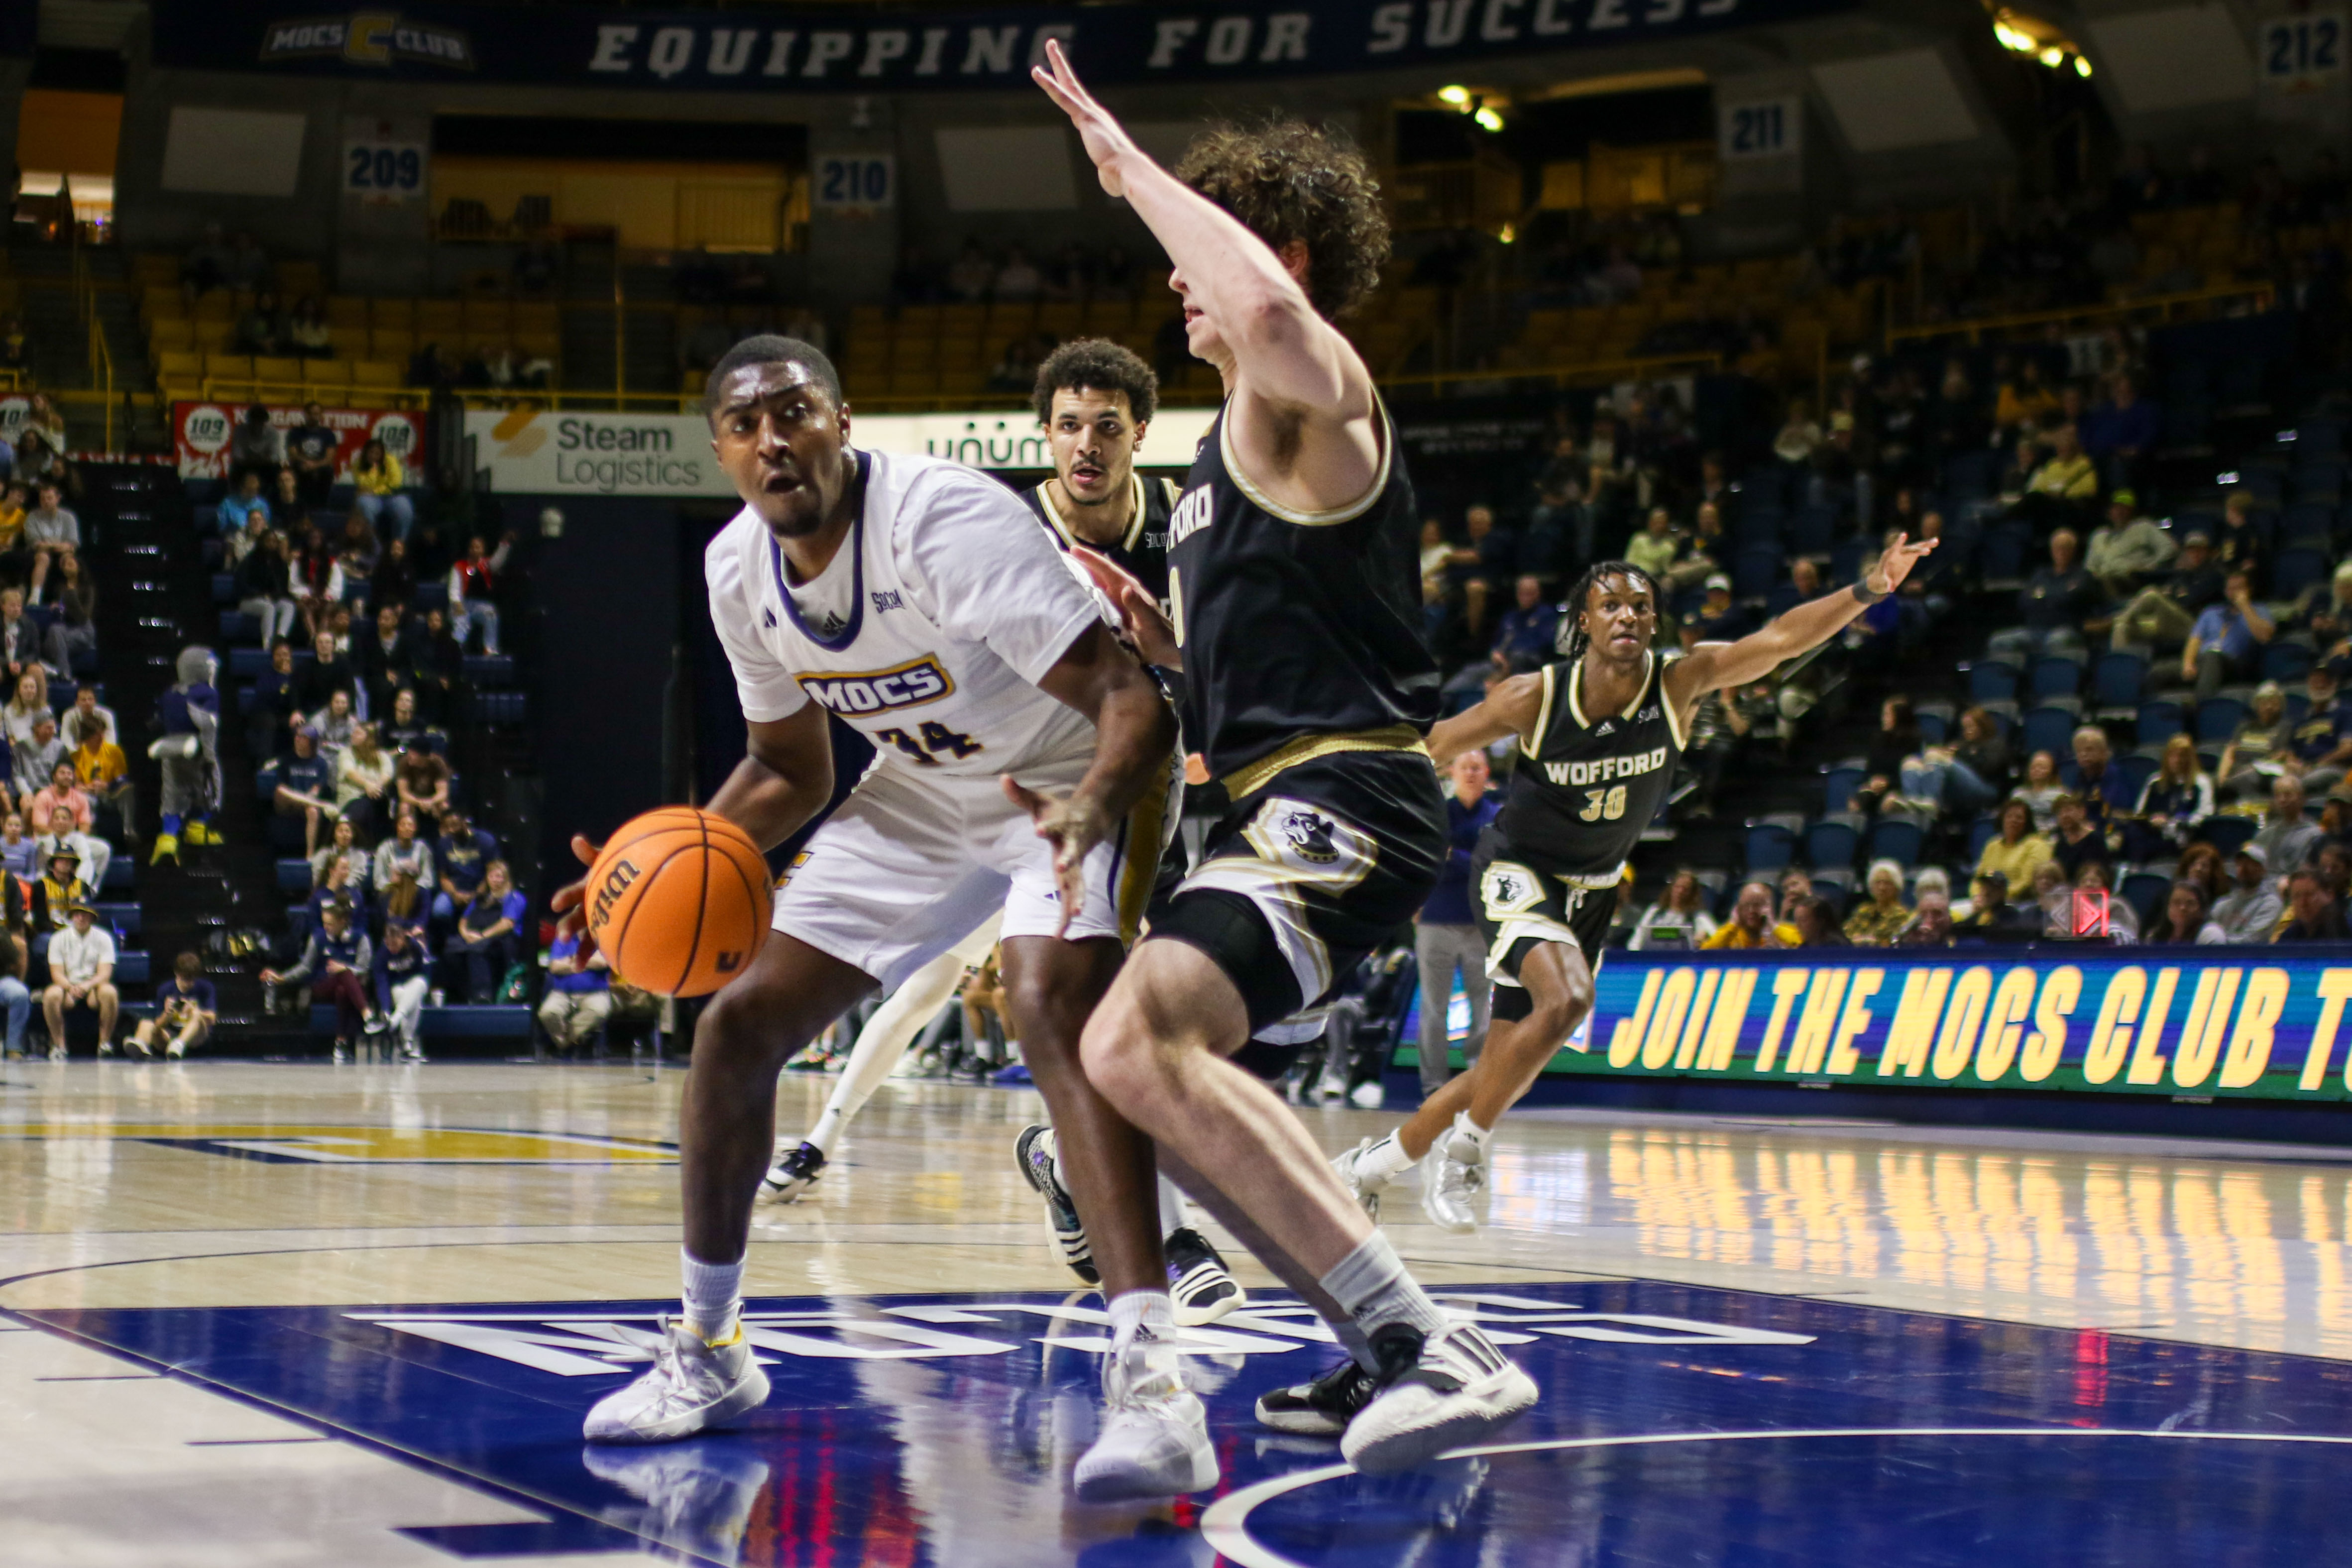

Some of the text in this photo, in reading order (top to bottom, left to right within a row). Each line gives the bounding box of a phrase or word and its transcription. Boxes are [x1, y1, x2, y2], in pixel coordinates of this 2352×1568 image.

[271, 24, 343, 51] MOCS
[396, 29, 464, 60] CLUB
[588, 24, 1077, 80] EQUIPPING
[1146, 12, 1312, 69] FOR
[2269, 20, 2339, 73] 212
[1734, 106, 1783, 151] 211
[350, 147, 420, 188] 209
[824, 161, 886, 200] 210
[191, 417, 224, 435] 109
[558, 418, 672, 450] Steam
[557, 452, 700, 492] Logistics
[803, 668, 942, 712] MOCS
[1544, 747, 1667, 786] WOFFORD
[1579, 785, 1627, 822] 30
[1607, 967, 1759, 1071] JOIN
[1754, 967, 1886, 1075] THE
[1877, 965, 2083, 1083] MOCS
[2083, 966, 2290, 1088] CLUB
